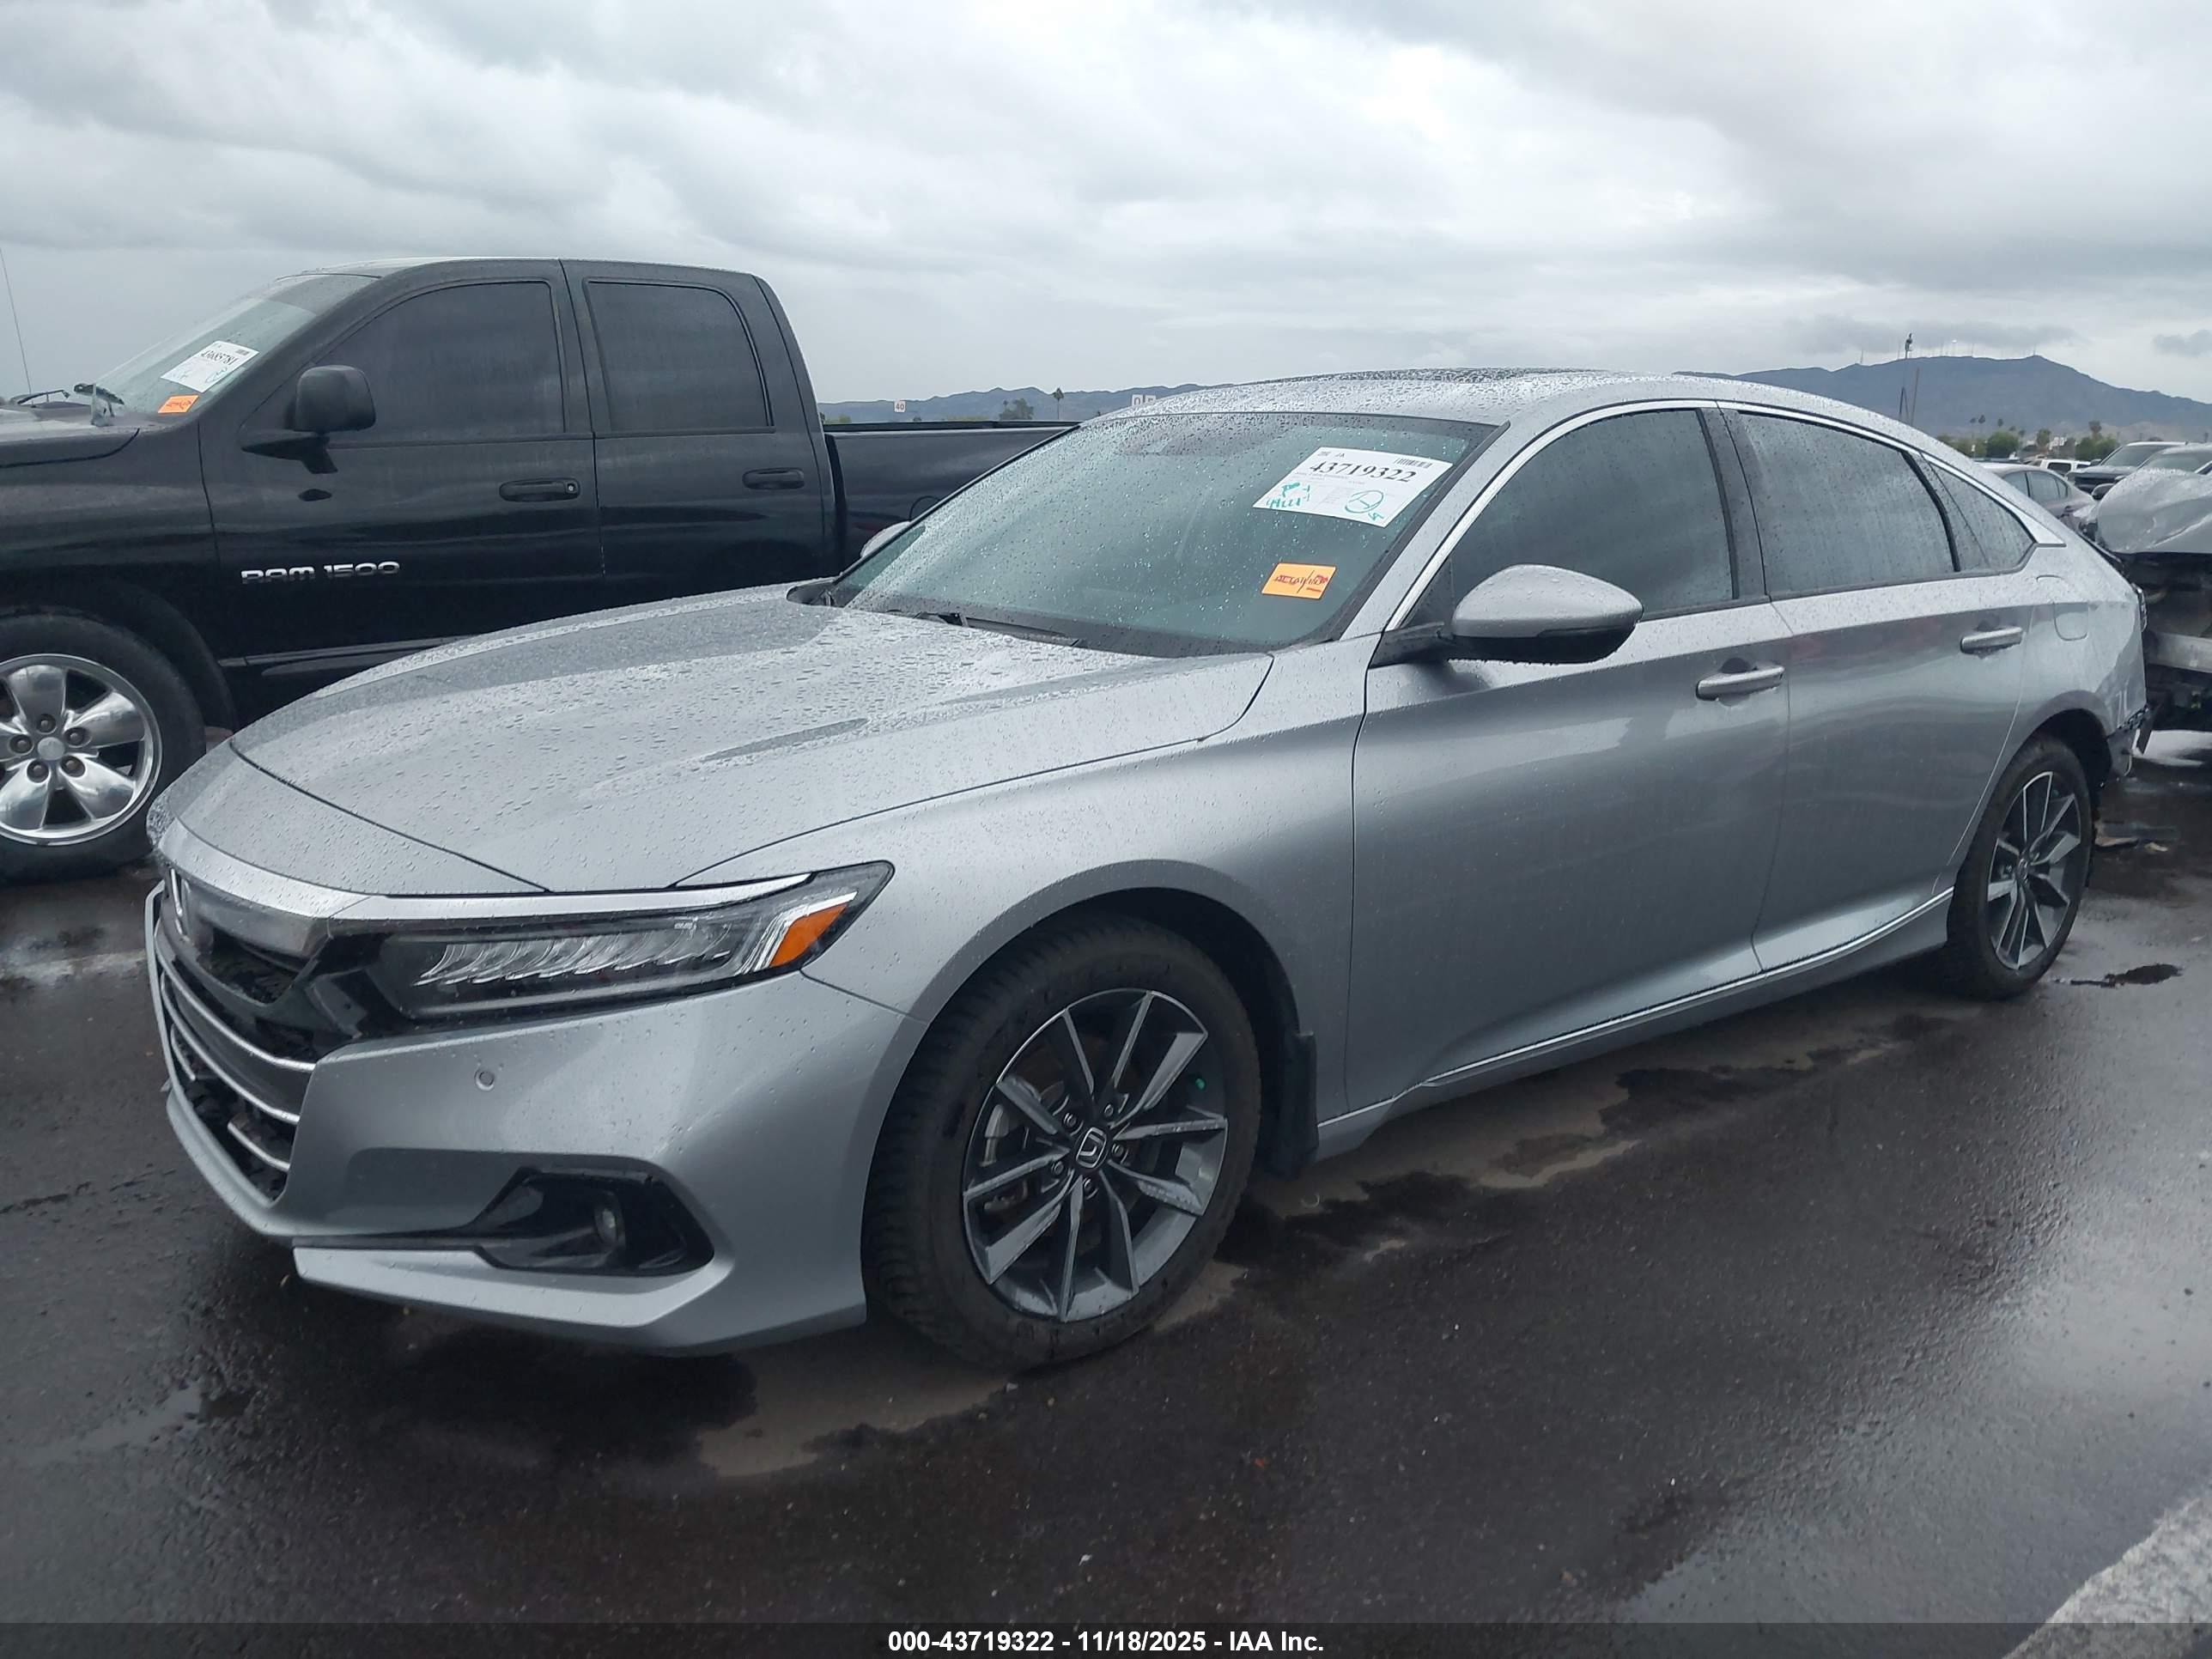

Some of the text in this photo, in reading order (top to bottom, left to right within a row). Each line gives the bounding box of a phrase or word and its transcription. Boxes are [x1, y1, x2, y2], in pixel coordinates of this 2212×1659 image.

[895, 402, 905, 410] 40
[1310, 460, 1417, 483] 43719322
[323, 561, 400, 578] 1500
